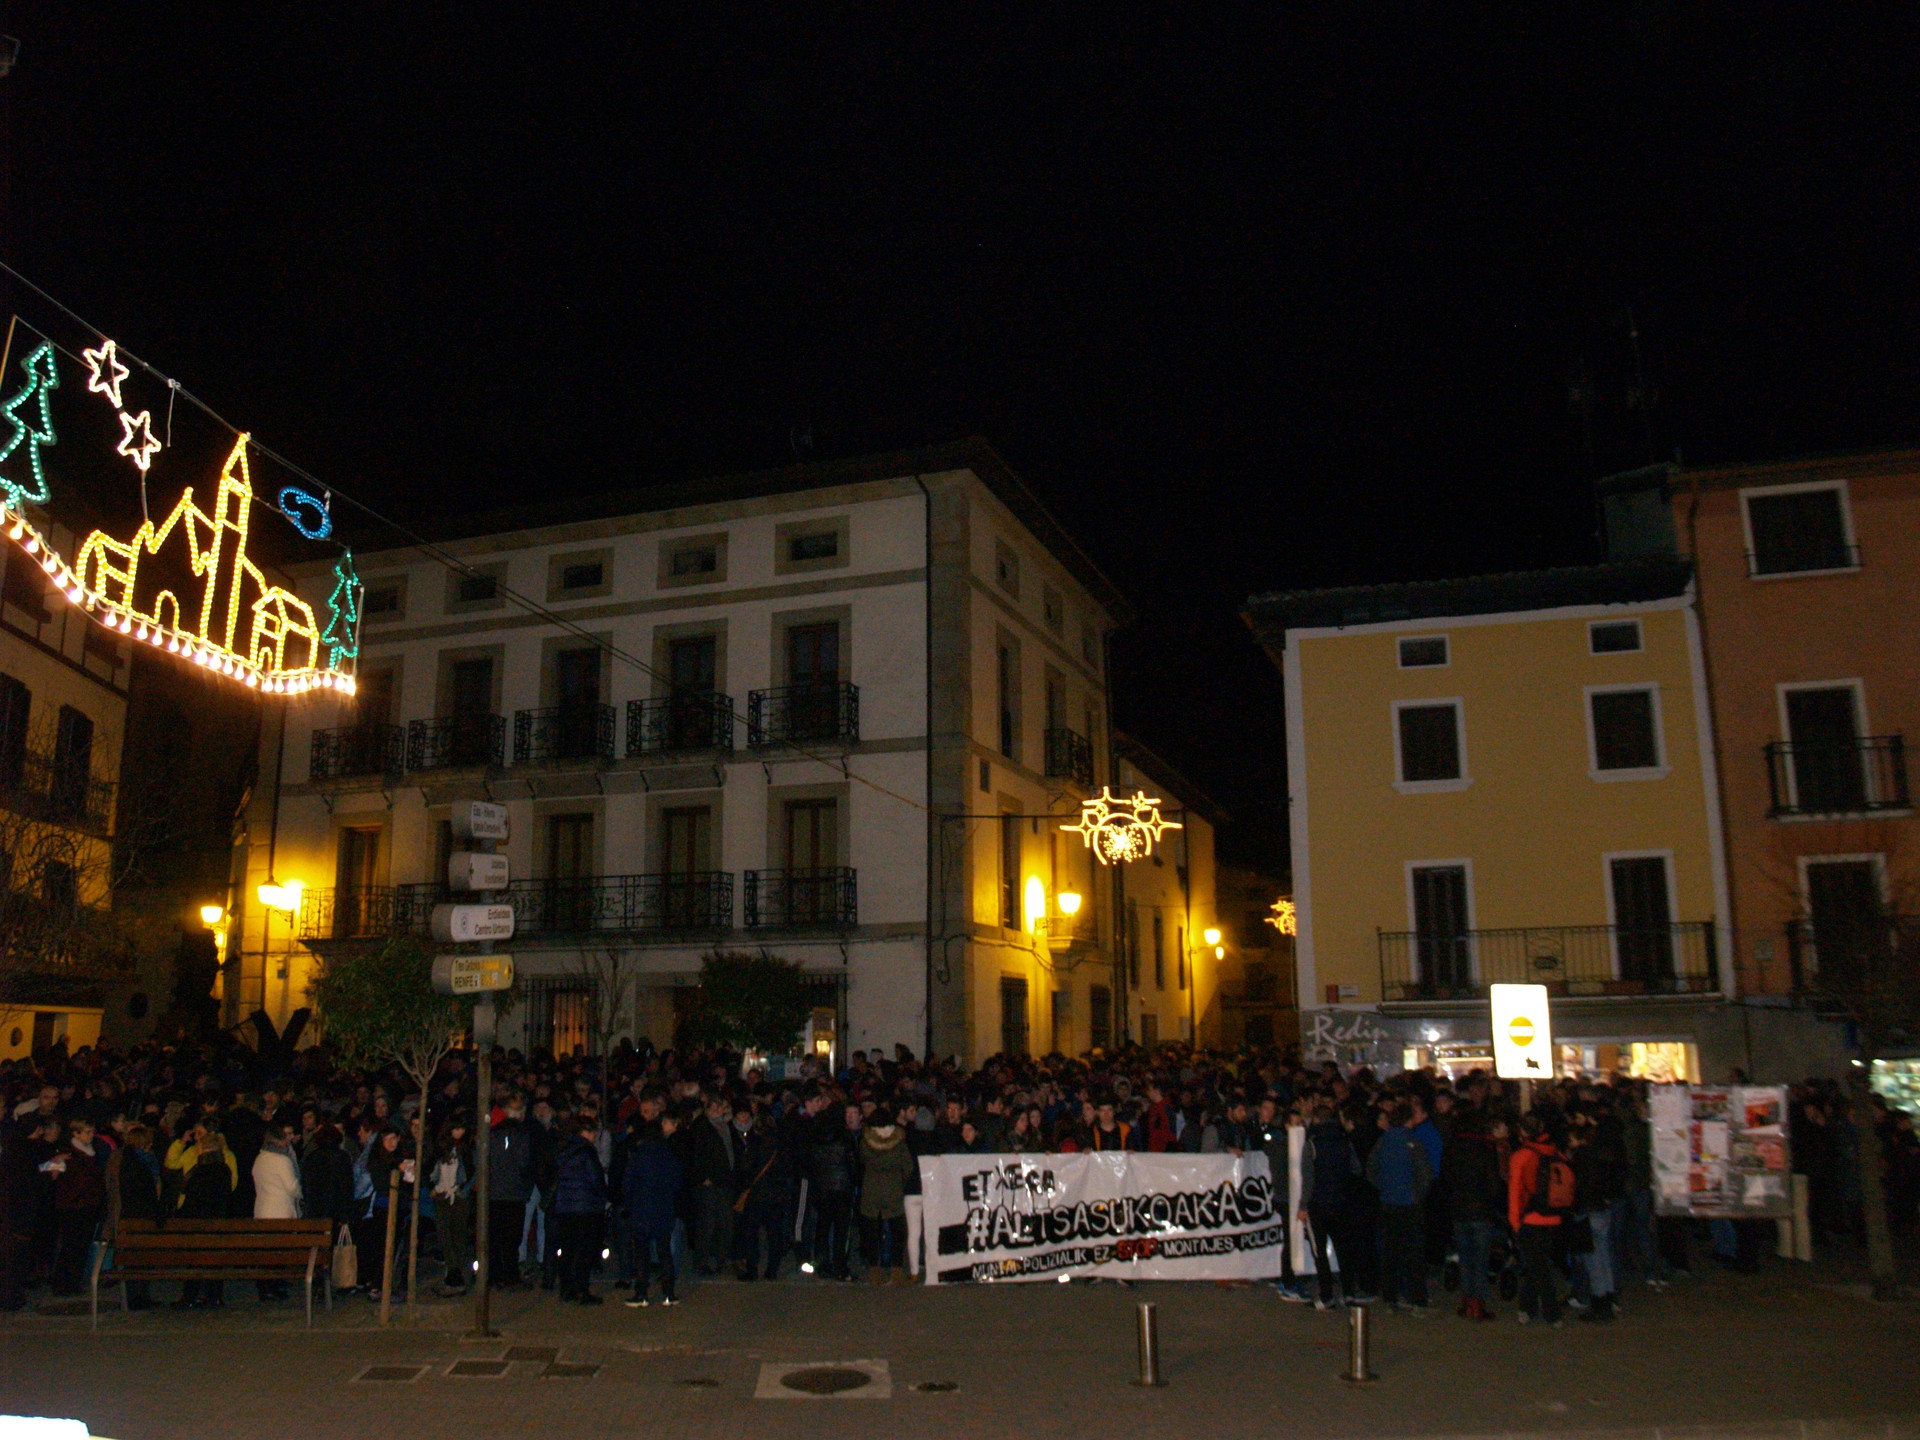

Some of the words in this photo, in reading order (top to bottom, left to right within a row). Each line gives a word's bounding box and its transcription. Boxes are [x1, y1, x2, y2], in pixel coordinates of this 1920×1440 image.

[454, 974, 474, 988] RENFE
[1115, 1237, 1159, 1261] STOP
[1163, 1236, 1235, 1257] MONTAJES
